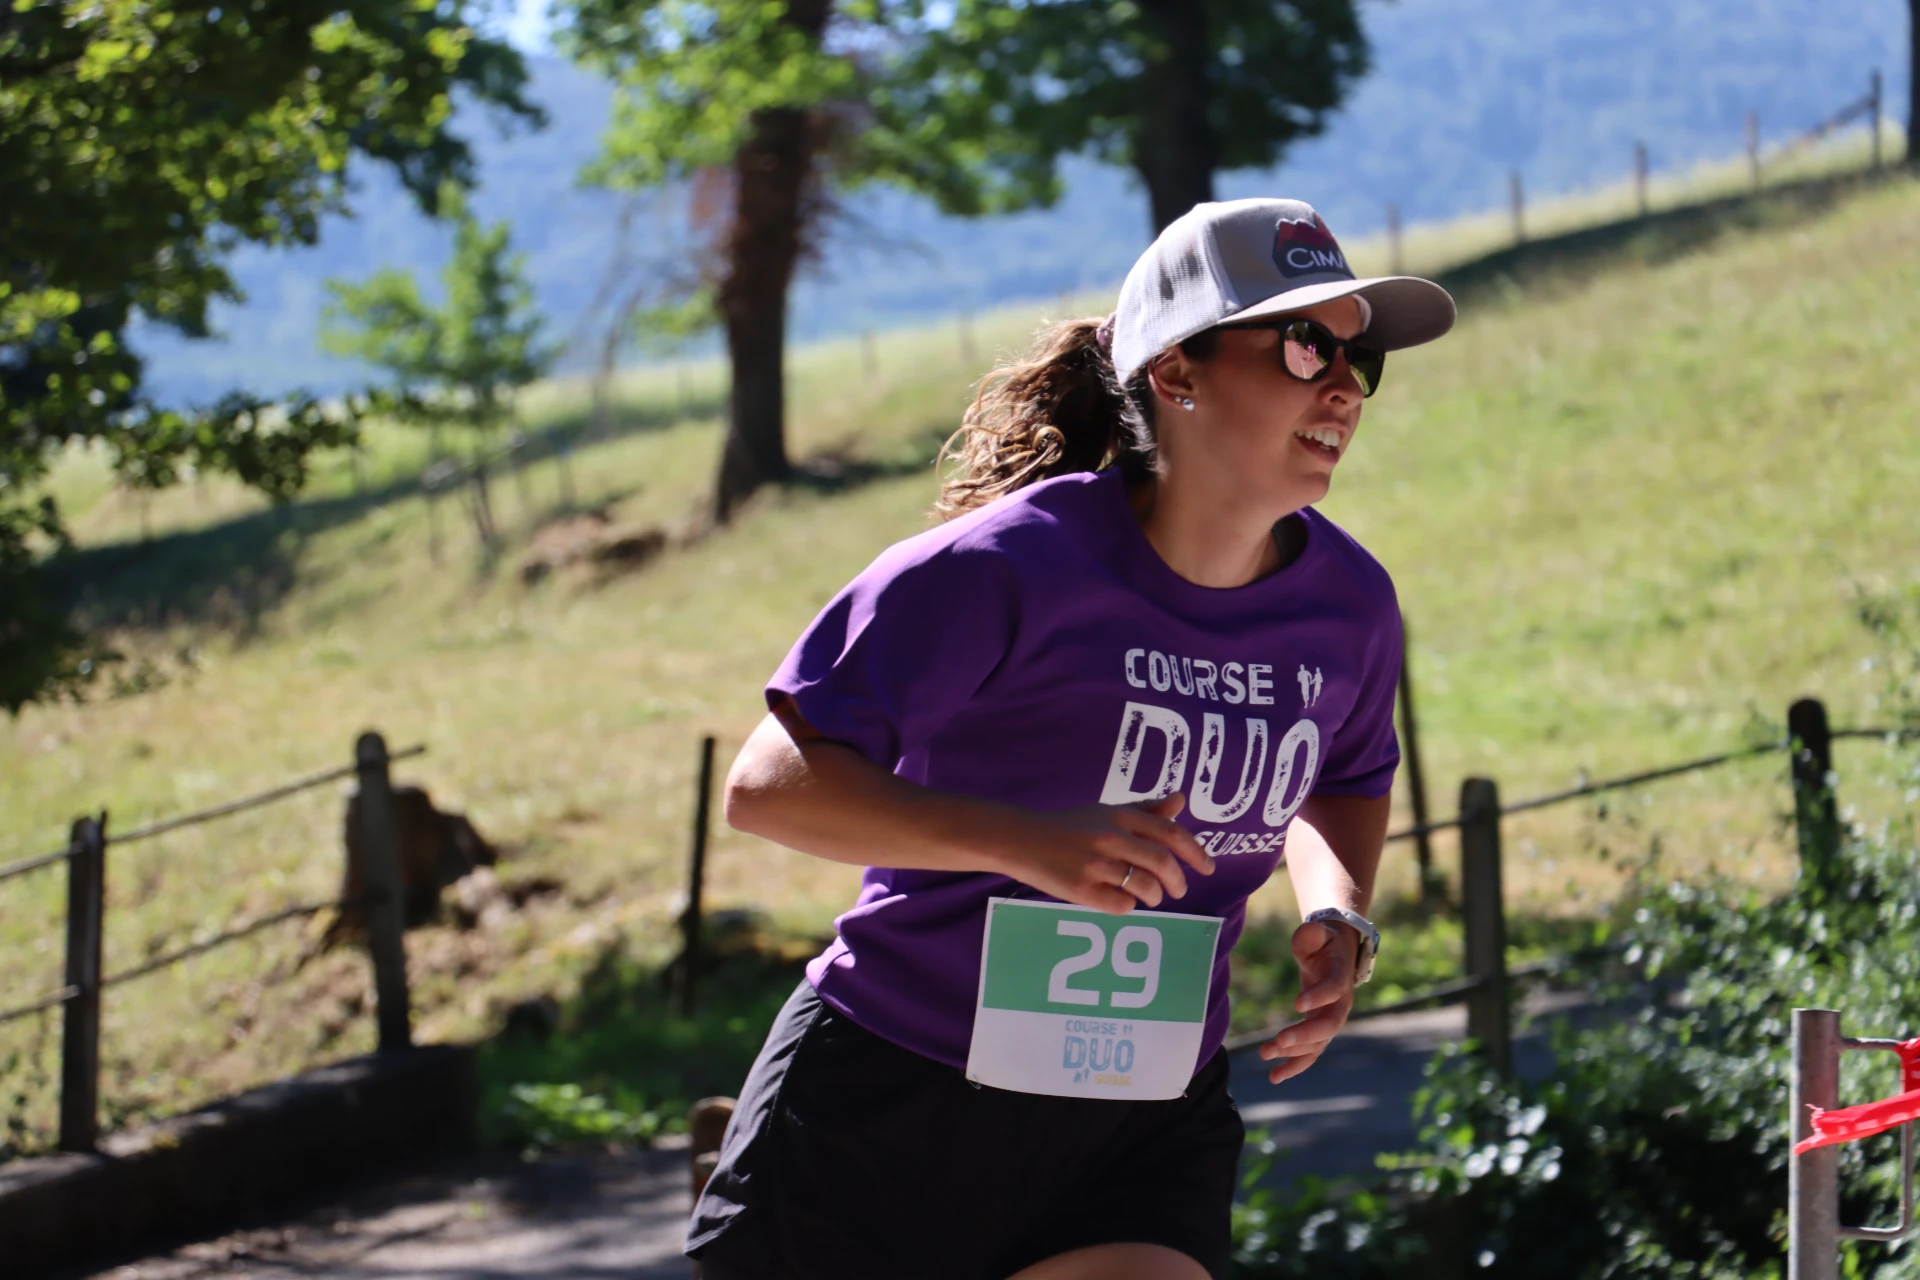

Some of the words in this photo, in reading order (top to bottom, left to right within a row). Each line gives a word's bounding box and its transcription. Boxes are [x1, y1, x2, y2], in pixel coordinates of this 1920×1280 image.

[1124, 647, 1275, 706] COURSE
[1098, 700, 1321, 828] DUO
[1047, 919, 1163, 1009] 29
[1062, 1035, 1135, 1074] DUO
[1065, 1019, 1118, 1036] COURSE
